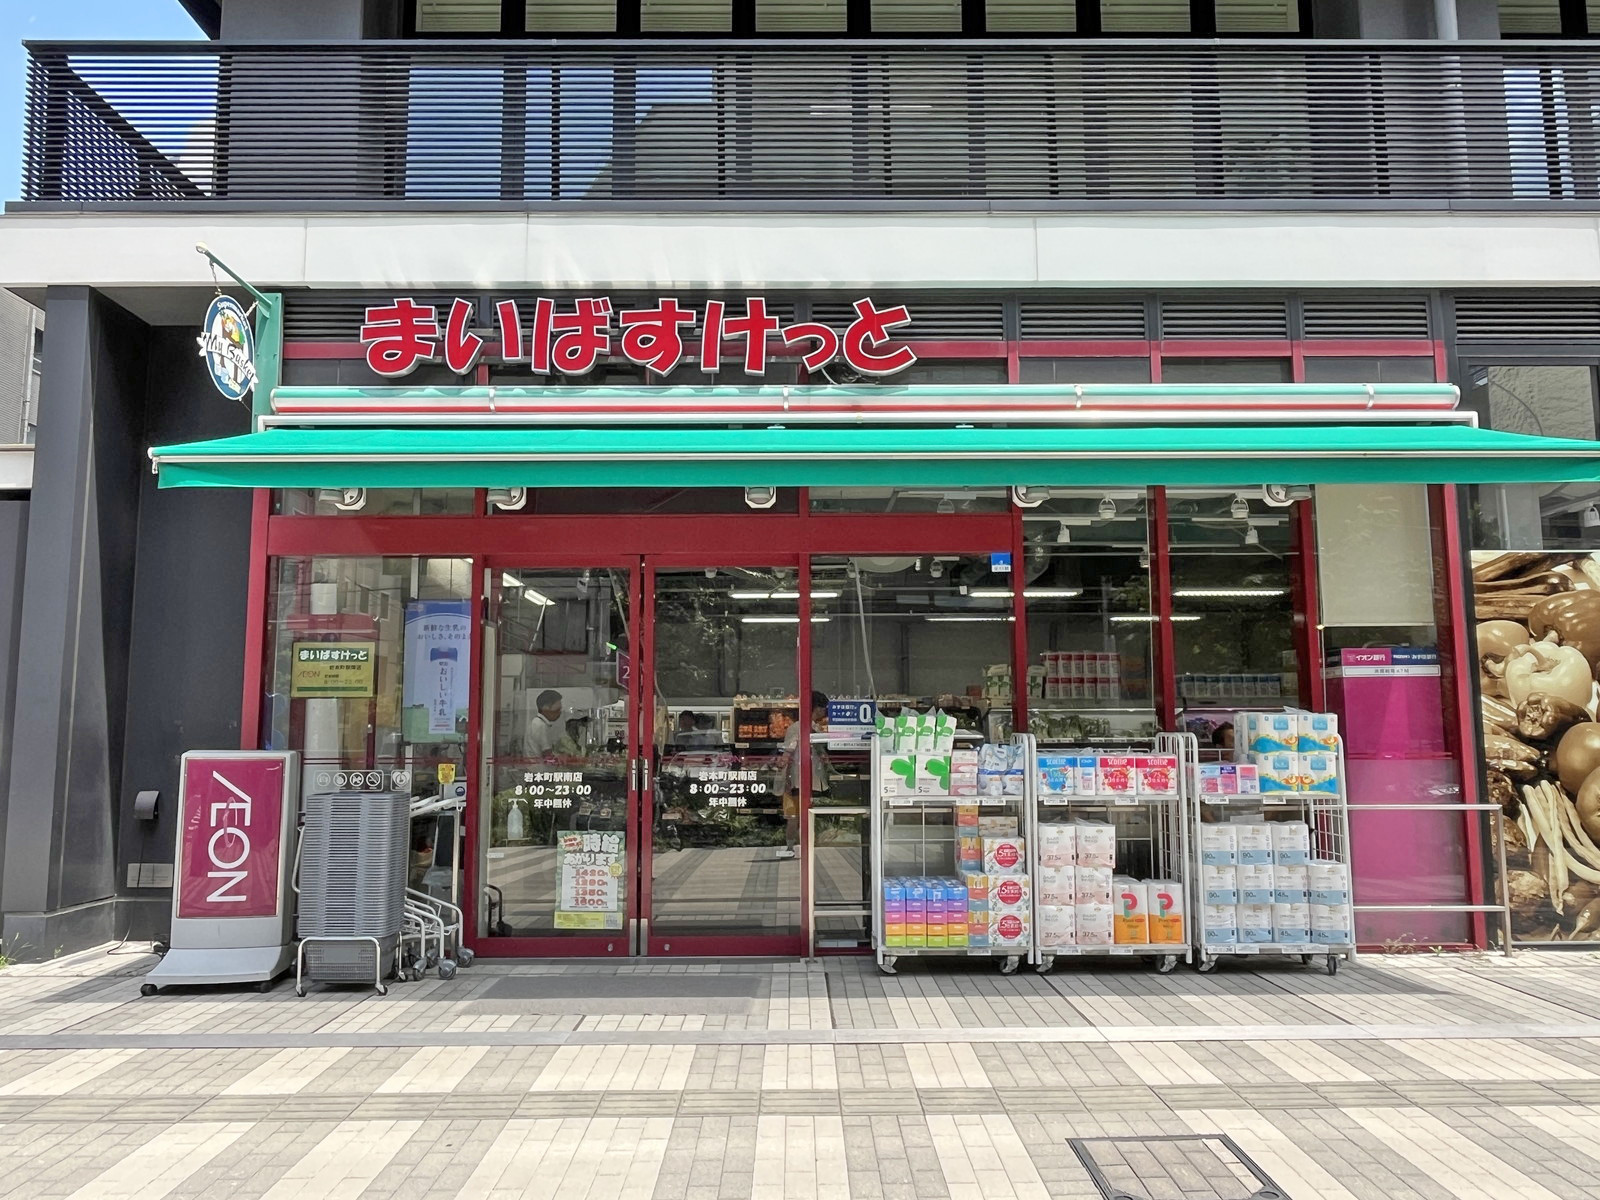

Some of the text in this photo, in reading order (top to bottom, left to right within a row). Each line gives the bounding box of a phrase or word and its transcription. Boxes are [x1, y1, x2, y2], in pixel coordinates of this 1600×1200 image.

[360, 297, 918, 378] まいばすけっと
[226, 342, 255, 382] Basket
[299, 649, 368, 660] まいばすけっと
[524, 772, 583, 782] 岩本町駅南店
[698, 770, 758, 781] 岩本町駅南店
[533, 798, 573, 808] 年中無休
[708, 796, 748, 807] 年中無休
[206, 770, 252, 903] AEON
[582, 832, 620, 853] 時給
[563, 852, 619, 867] あがります
